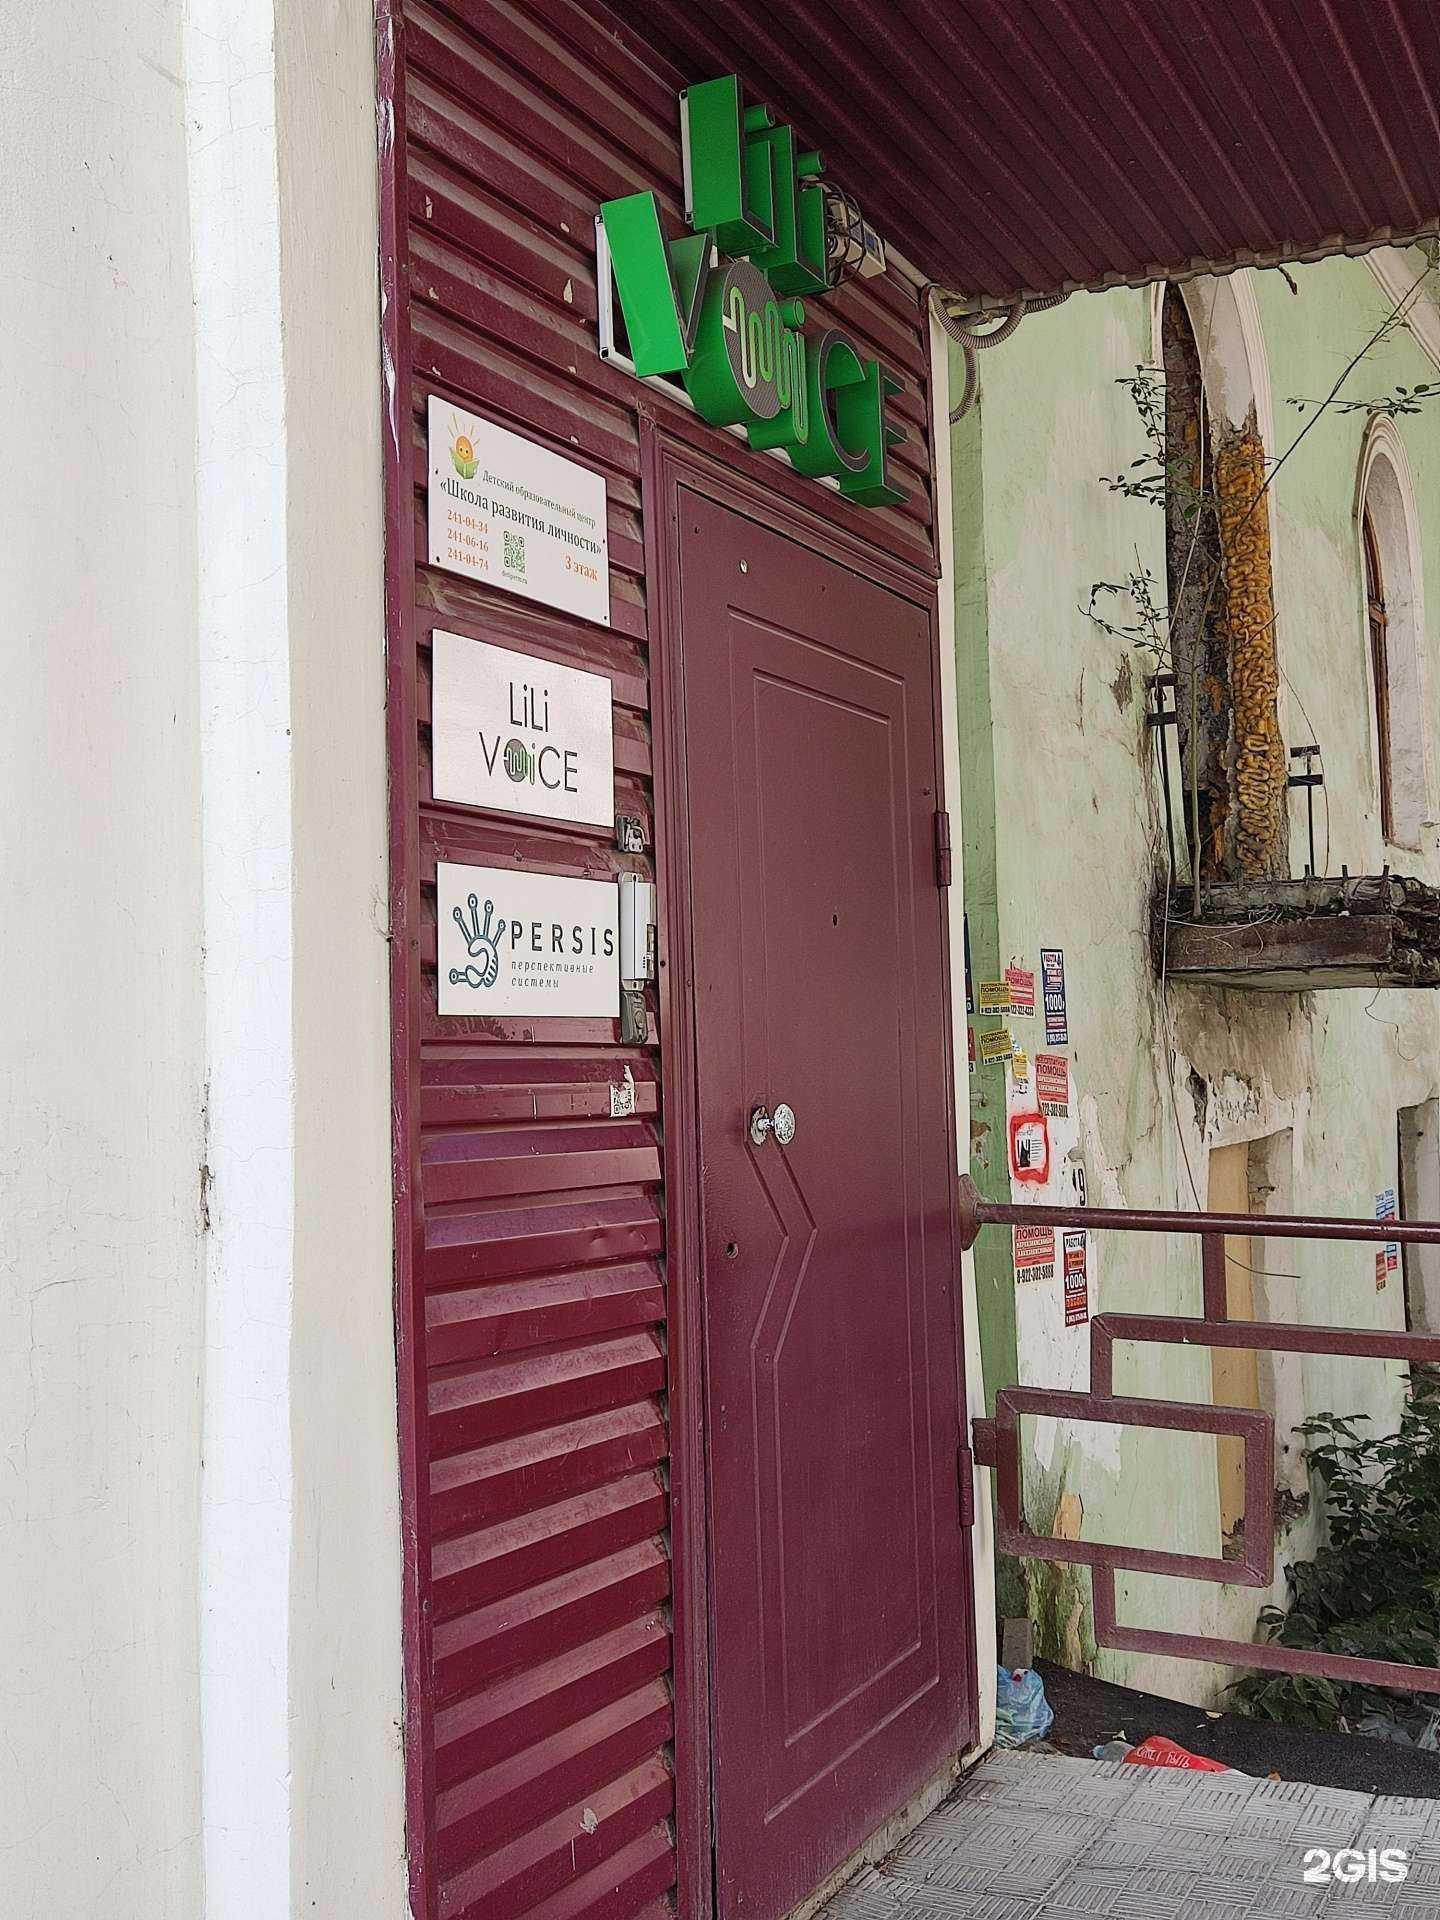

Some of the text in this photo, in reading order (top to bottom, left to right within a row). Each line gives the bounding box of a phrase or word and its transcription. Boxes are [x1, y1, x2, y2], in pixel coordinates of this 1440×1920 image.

[482, 470, 596, 529] Детский образовательный центр
[440, 477, 601, 555] «Школа развития личности»
[564, 554, 598, 582] 3 этаж
[511, 920, 615, 957] PERSIS
[511, 960, 595, 975] перспективные
[511, 977, 560, 989] системы
[1016, 1225, 1053, 1239] ПОМОЩЬ
